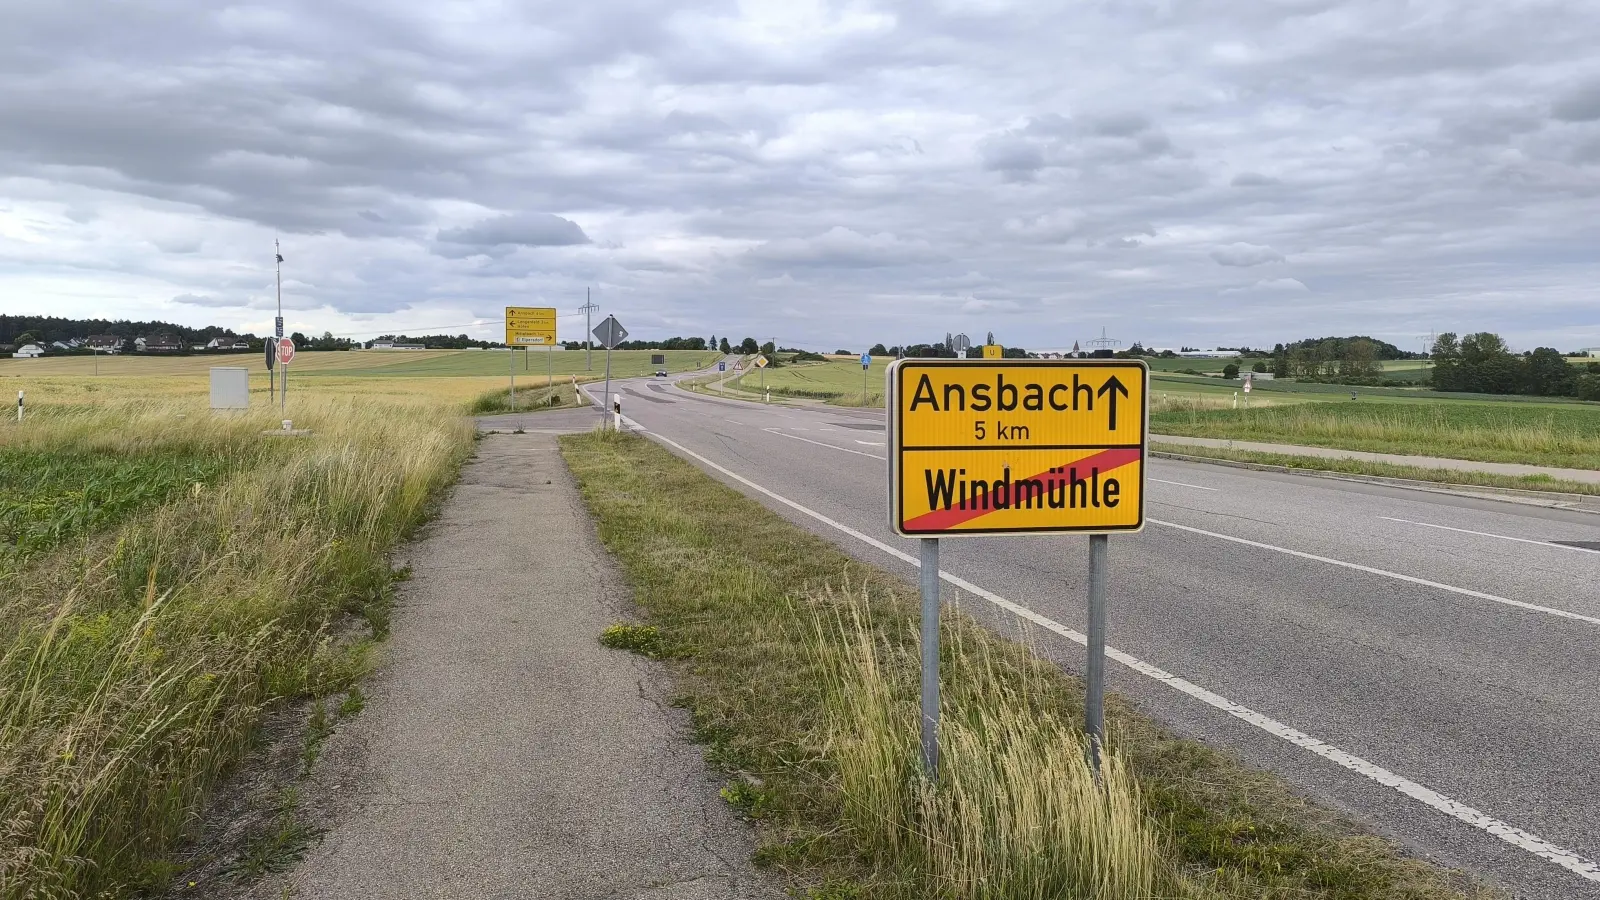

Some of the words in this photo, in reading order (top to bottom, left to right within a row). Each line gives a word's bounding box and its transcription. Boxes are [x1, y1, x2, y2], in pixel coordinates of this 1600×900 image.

[909, 373, 1094, 412] Ansbach
[974, 421, 986, 440] 5
[997, 420, 1030, 440] km
[924, 467, 1120, 511] Windmühle
